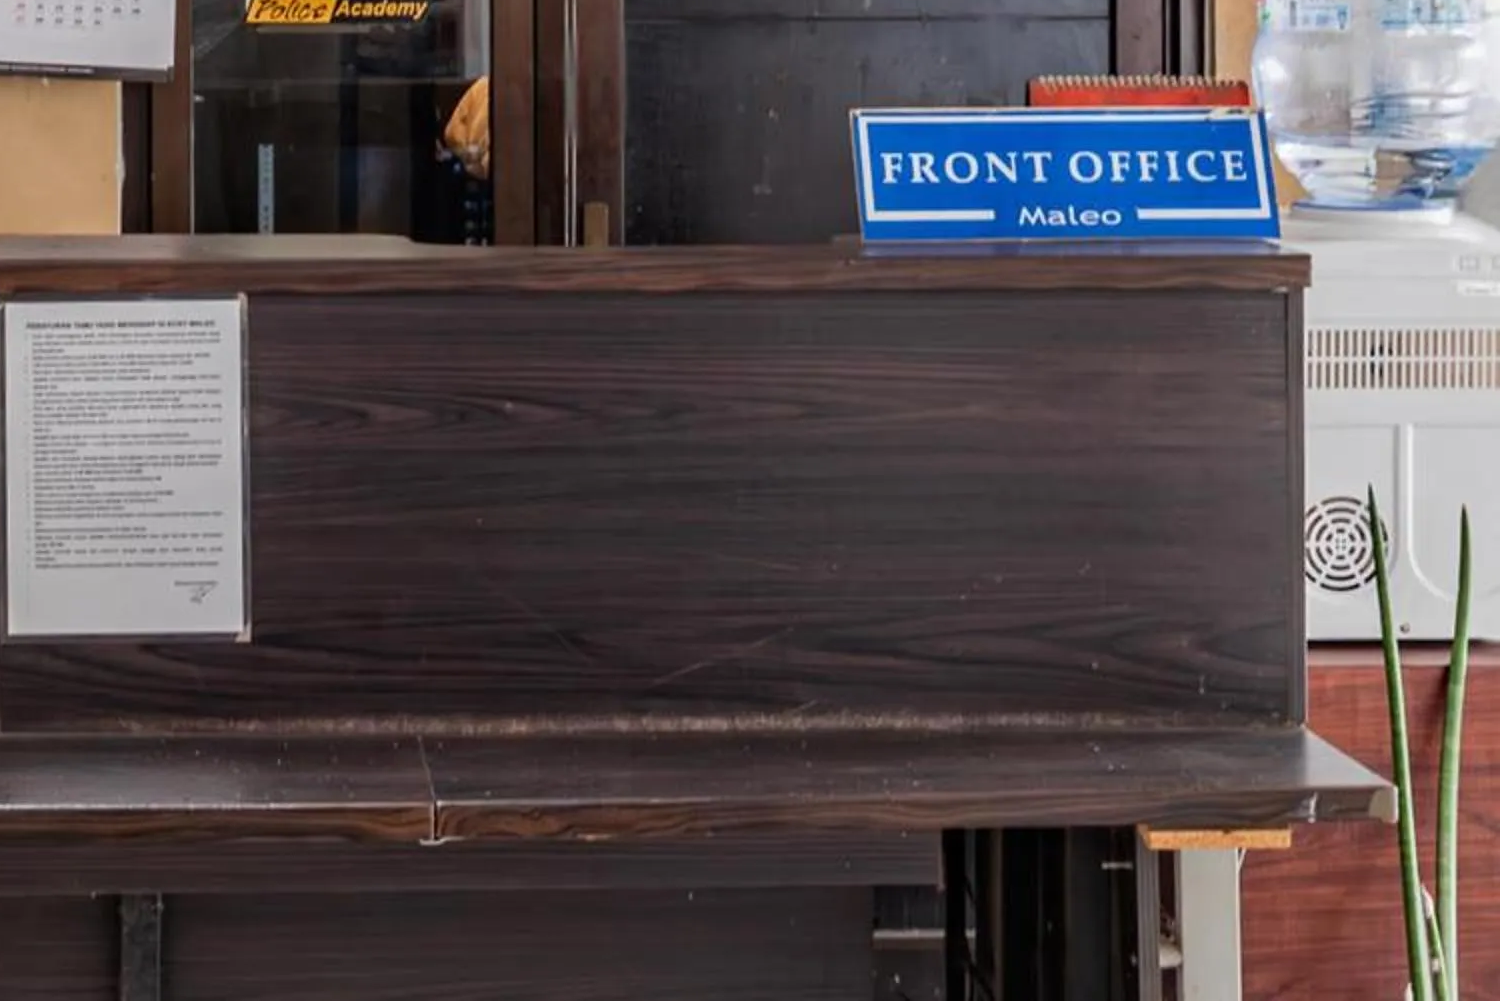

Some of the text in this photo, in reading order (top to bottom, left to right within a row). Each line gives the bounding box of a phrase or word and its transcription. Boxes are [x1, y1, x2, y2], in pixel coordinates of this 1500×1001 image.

[879, 150, 1248, 185] FRONT OFFICE
[1018, 205, 1122, 227] Maleo
